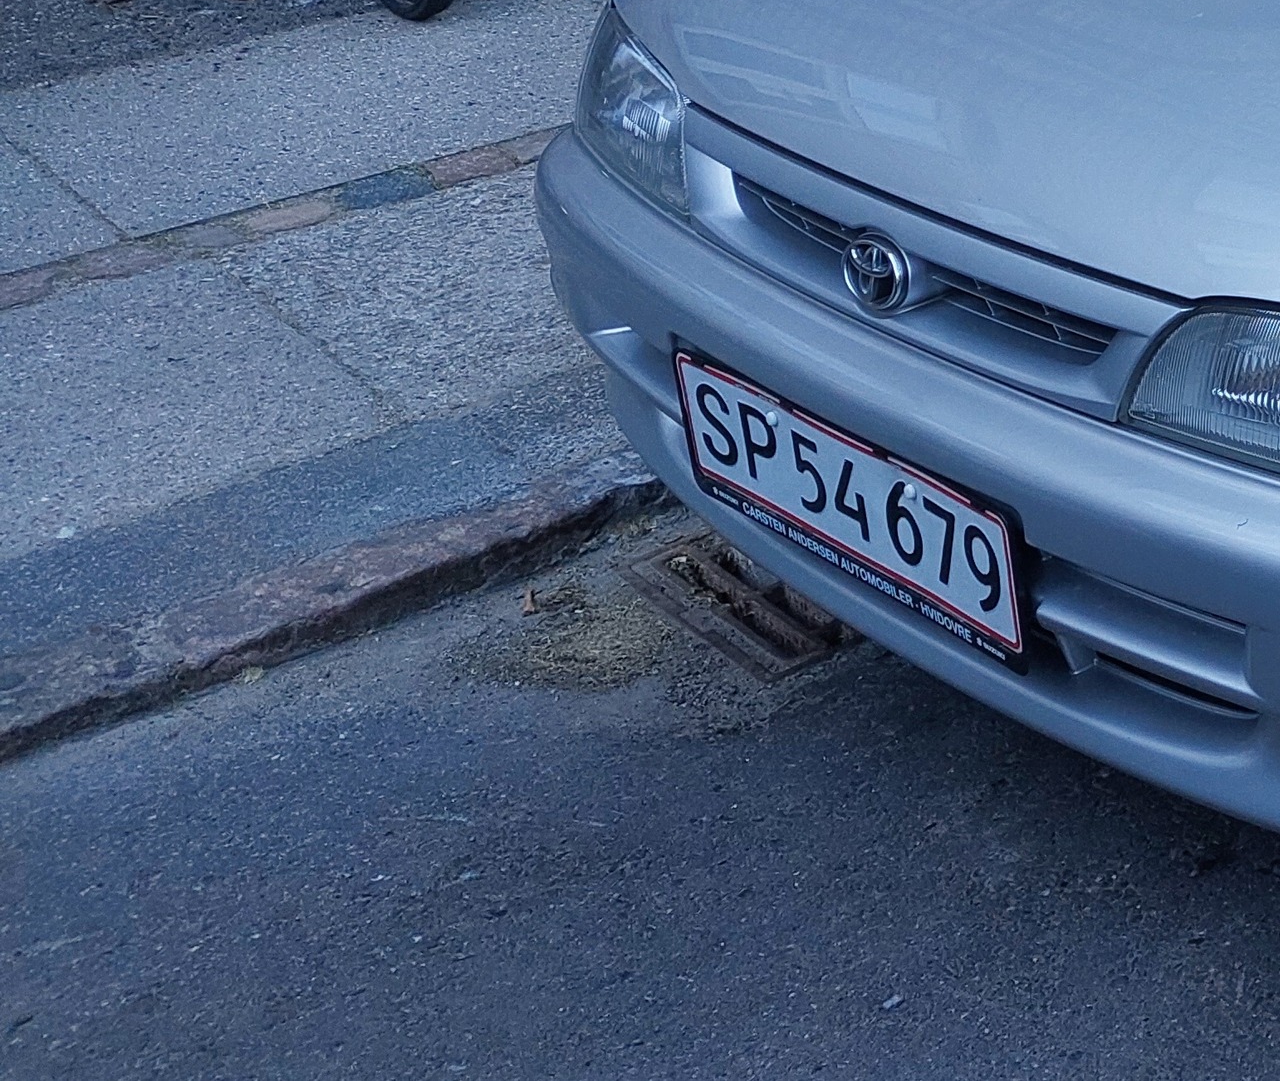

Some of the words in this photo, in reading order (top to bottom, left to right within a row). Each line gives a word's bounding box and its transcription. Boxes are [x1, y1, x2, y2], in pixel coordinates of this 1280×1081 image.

[696, 383, 777, 480] SP
[791, 429, 870, 542] 54
[886, 480, 1001, 612] 679
[742, 501, 787, 536] CARSTEN
[788, 526, 839, 566] ANDERSEN
[841, 556, 914, 609] AUTOMOBILER
[920, 601, 973, 644] HVIDOVRE
